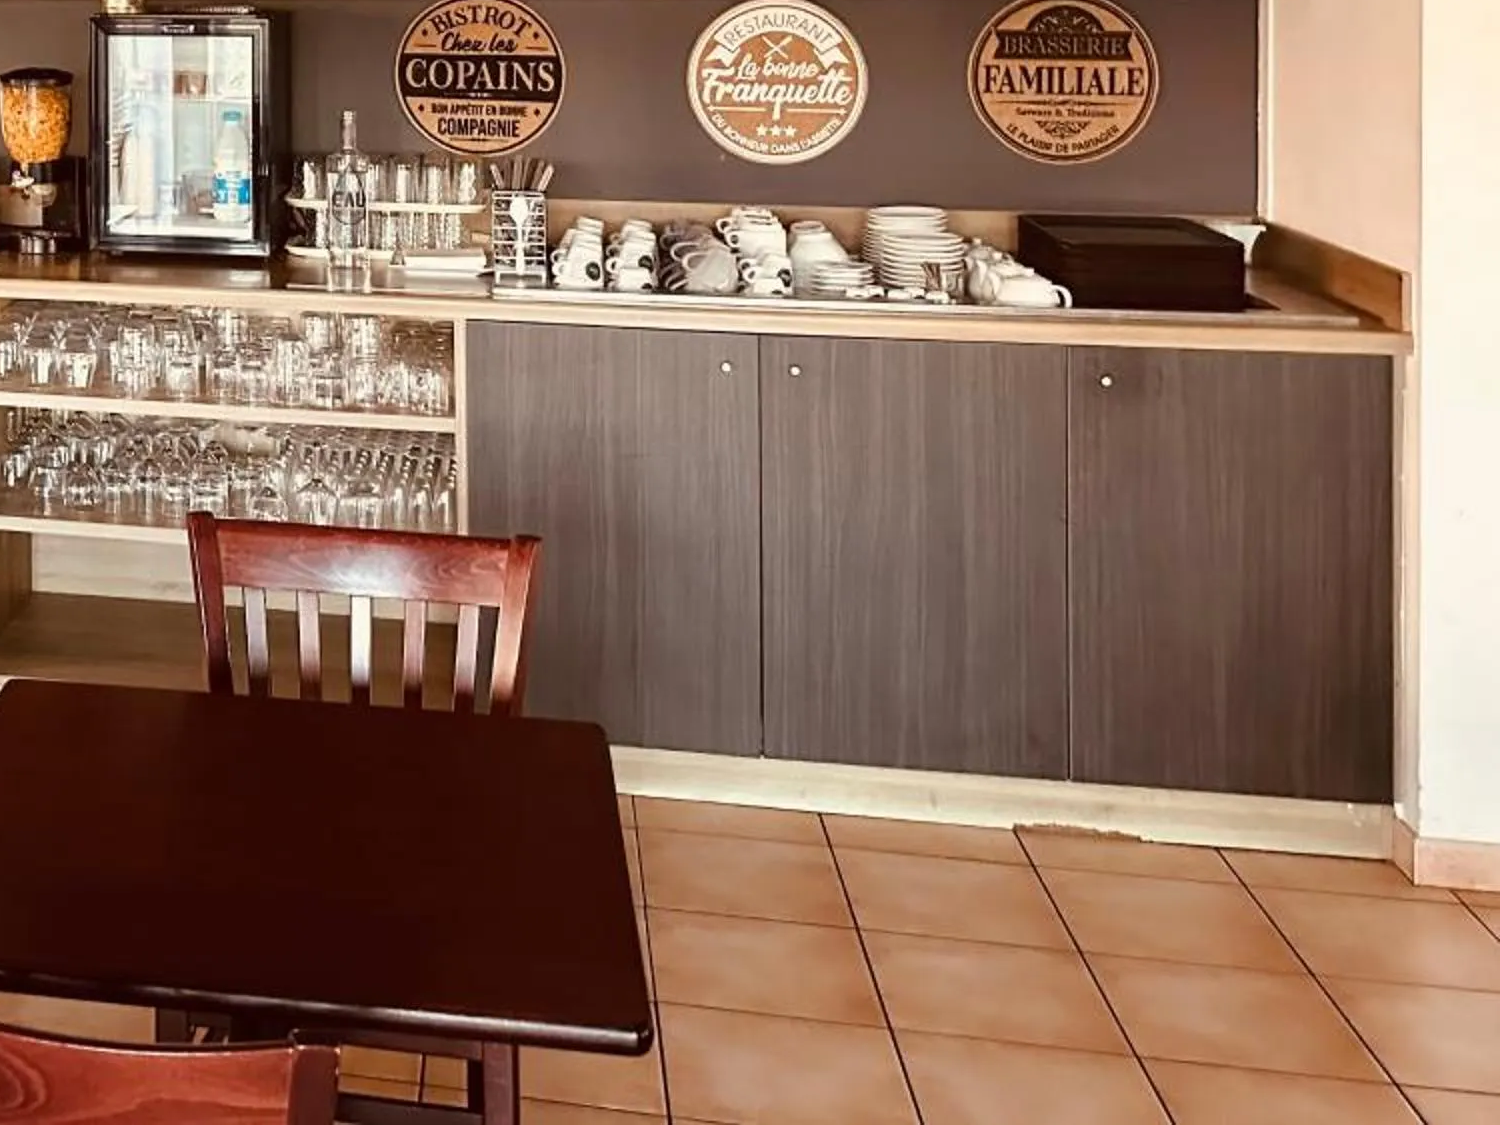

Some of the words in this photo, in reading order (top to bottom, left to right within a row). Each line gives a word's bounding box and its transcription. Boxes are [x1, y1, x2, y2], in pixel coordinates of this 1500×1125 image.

[428, 5, 532, 38] BISTROT
[723, 13, 833, 48] RESTAURANT
[440, 32, 484, 52] Chez
[488, 32, 519, 52] les
[1004, 34, 1126, 56] BRASSERIE
[405, 58, 555, 92] COPAINS
[735, 53, 760, 81] La
[763, 56, 820, 80] bonne
[983, 65, 1145, 96] FAMILIALE
[702, 68, 854, 121] Franquette
[437, 117, 521, 138] COMPAGNIE
[331, 190, 367, 208] EAU
